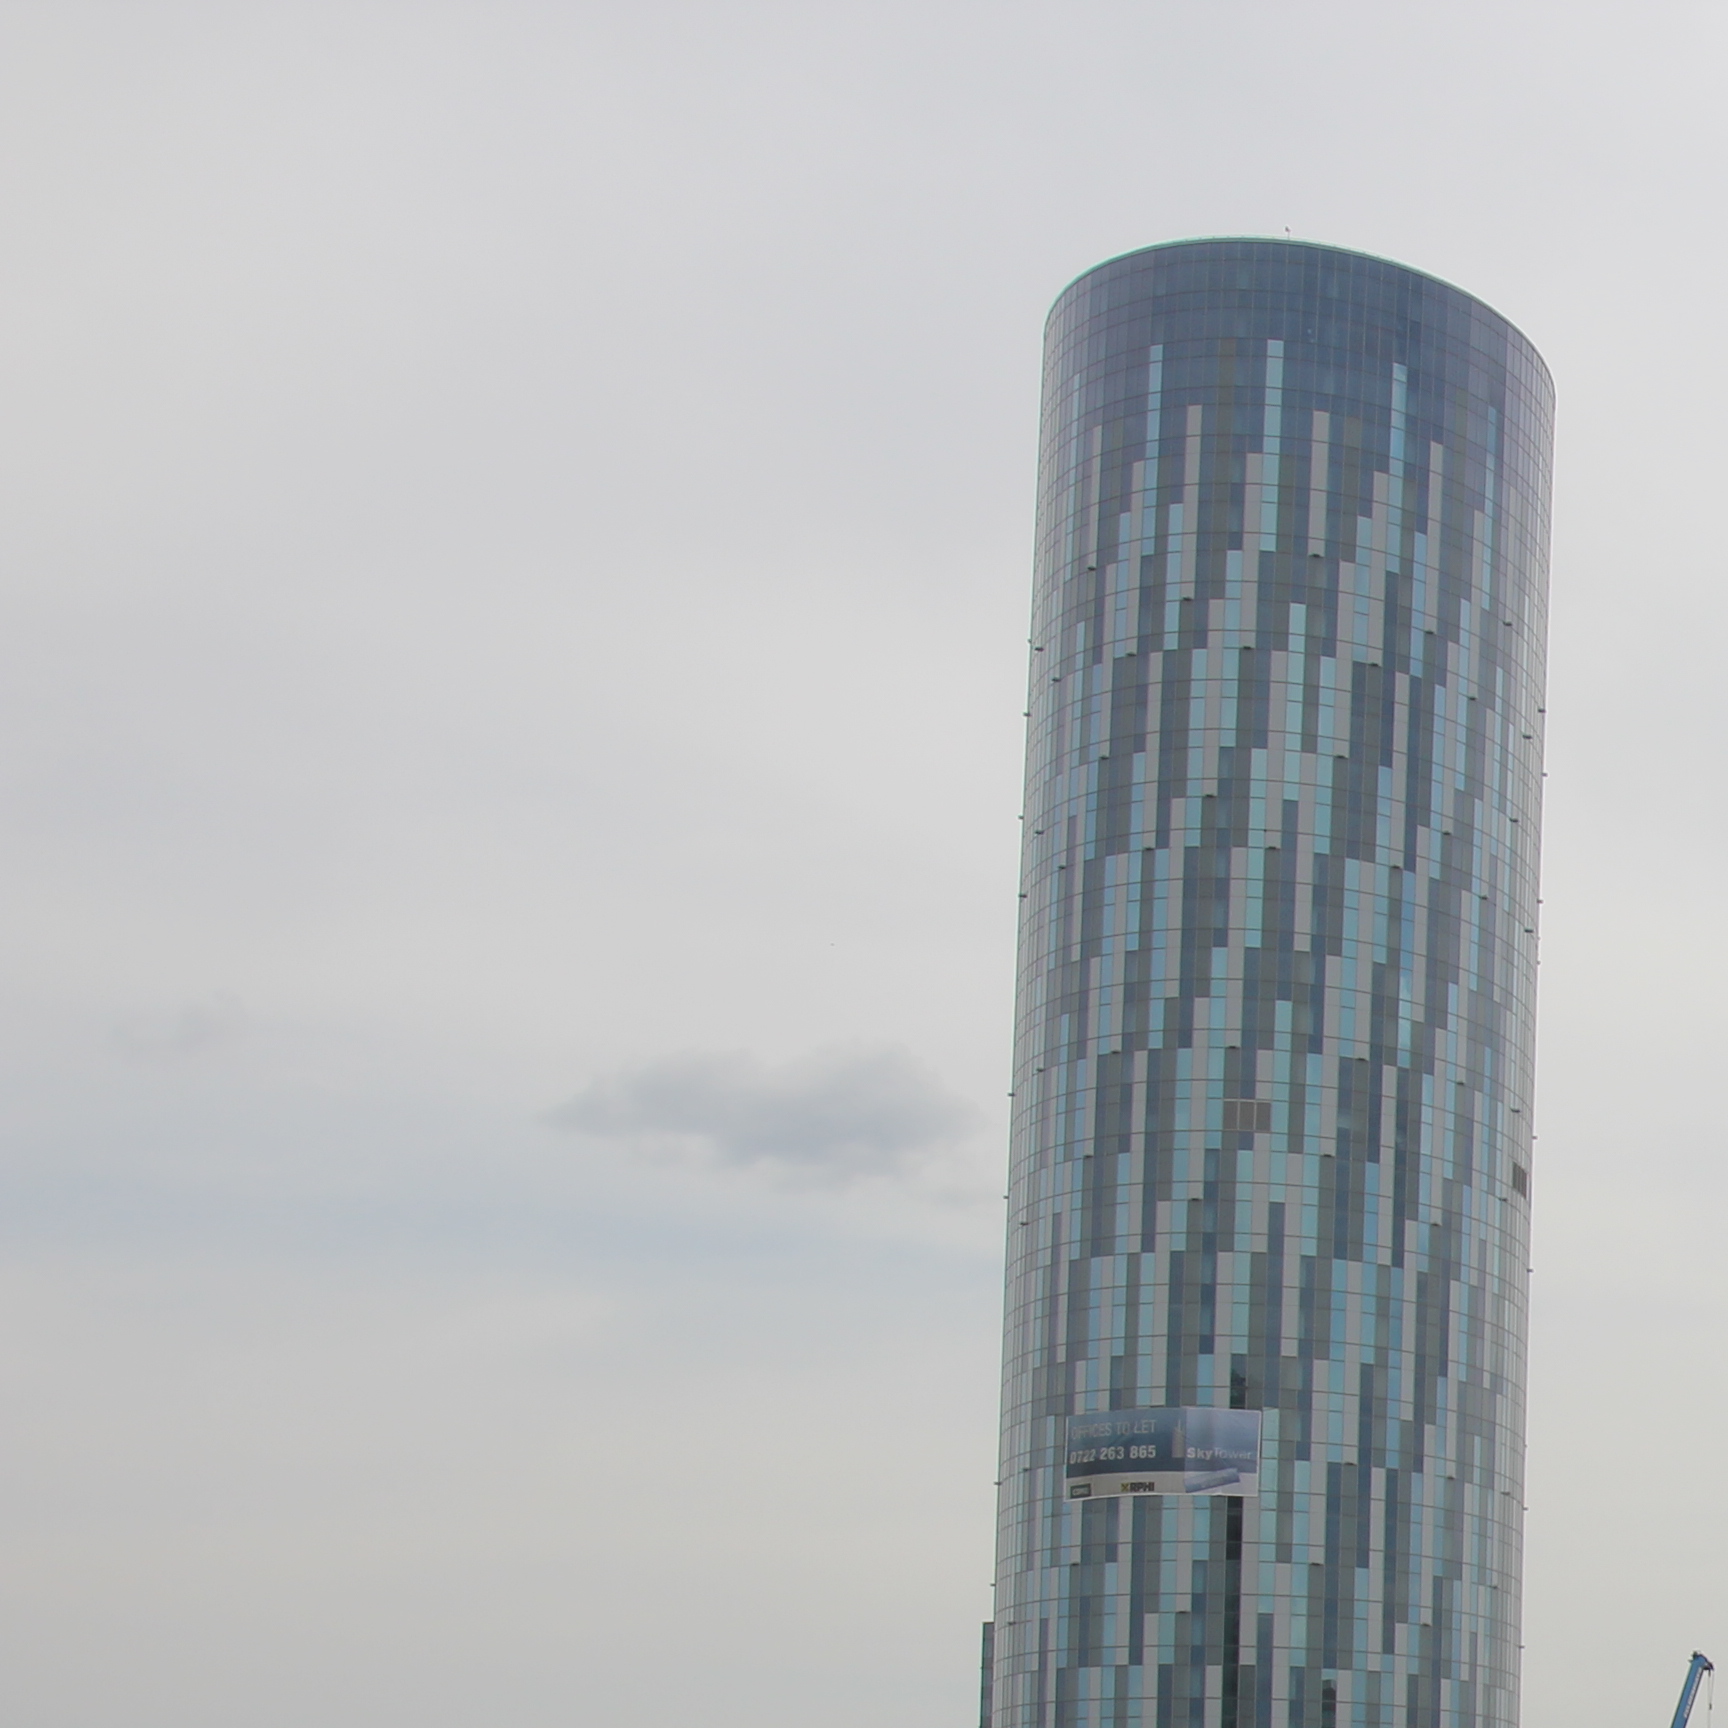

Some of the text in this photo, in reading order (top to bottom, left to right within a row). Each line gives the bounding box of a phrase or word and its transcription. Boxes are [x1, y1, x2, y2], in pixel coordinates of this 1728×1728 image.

[1071, 1420, 1157, 1440] OFFICES TO LET
[1100, 1446, 1124, 1461] 263
[1130, 1445, 1156, 1460] 865
